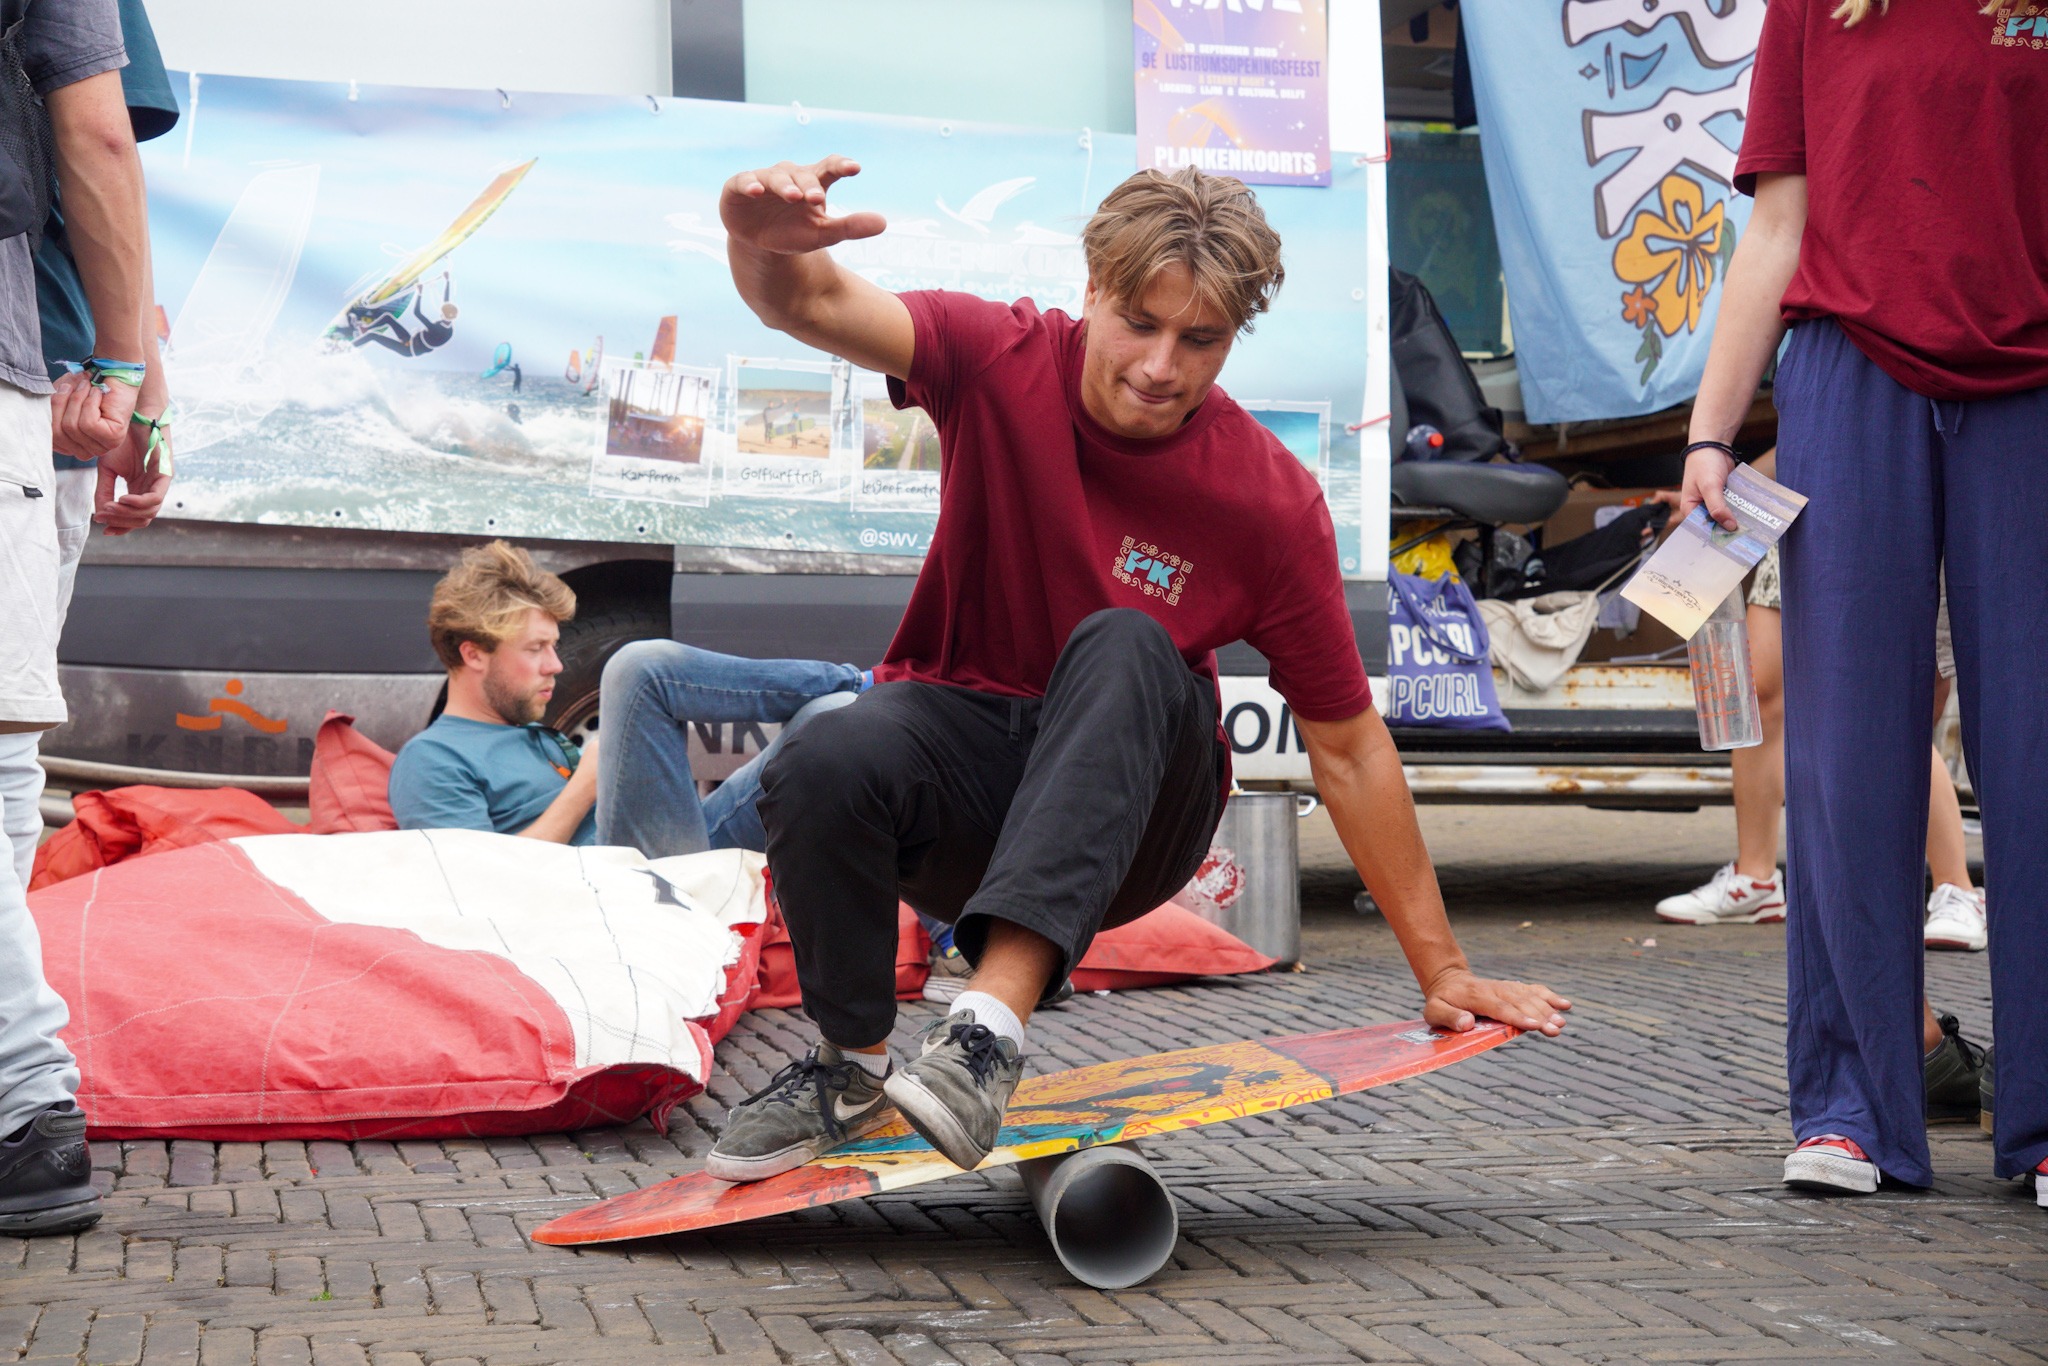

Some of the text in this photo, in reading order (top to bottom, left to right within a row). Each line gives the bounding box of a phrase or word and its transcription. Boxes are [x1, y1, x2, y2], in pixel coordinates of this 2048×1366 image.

[1141, 52, 1321, 78] 9E LUSTRUMSOPENINGSFEEST
[1154, 146, 1317, 175] PLANKENKOORTS
[1723, 487, 1783, 527] PLANKENKOORT
[1124, 550, 1177, 589] PK
